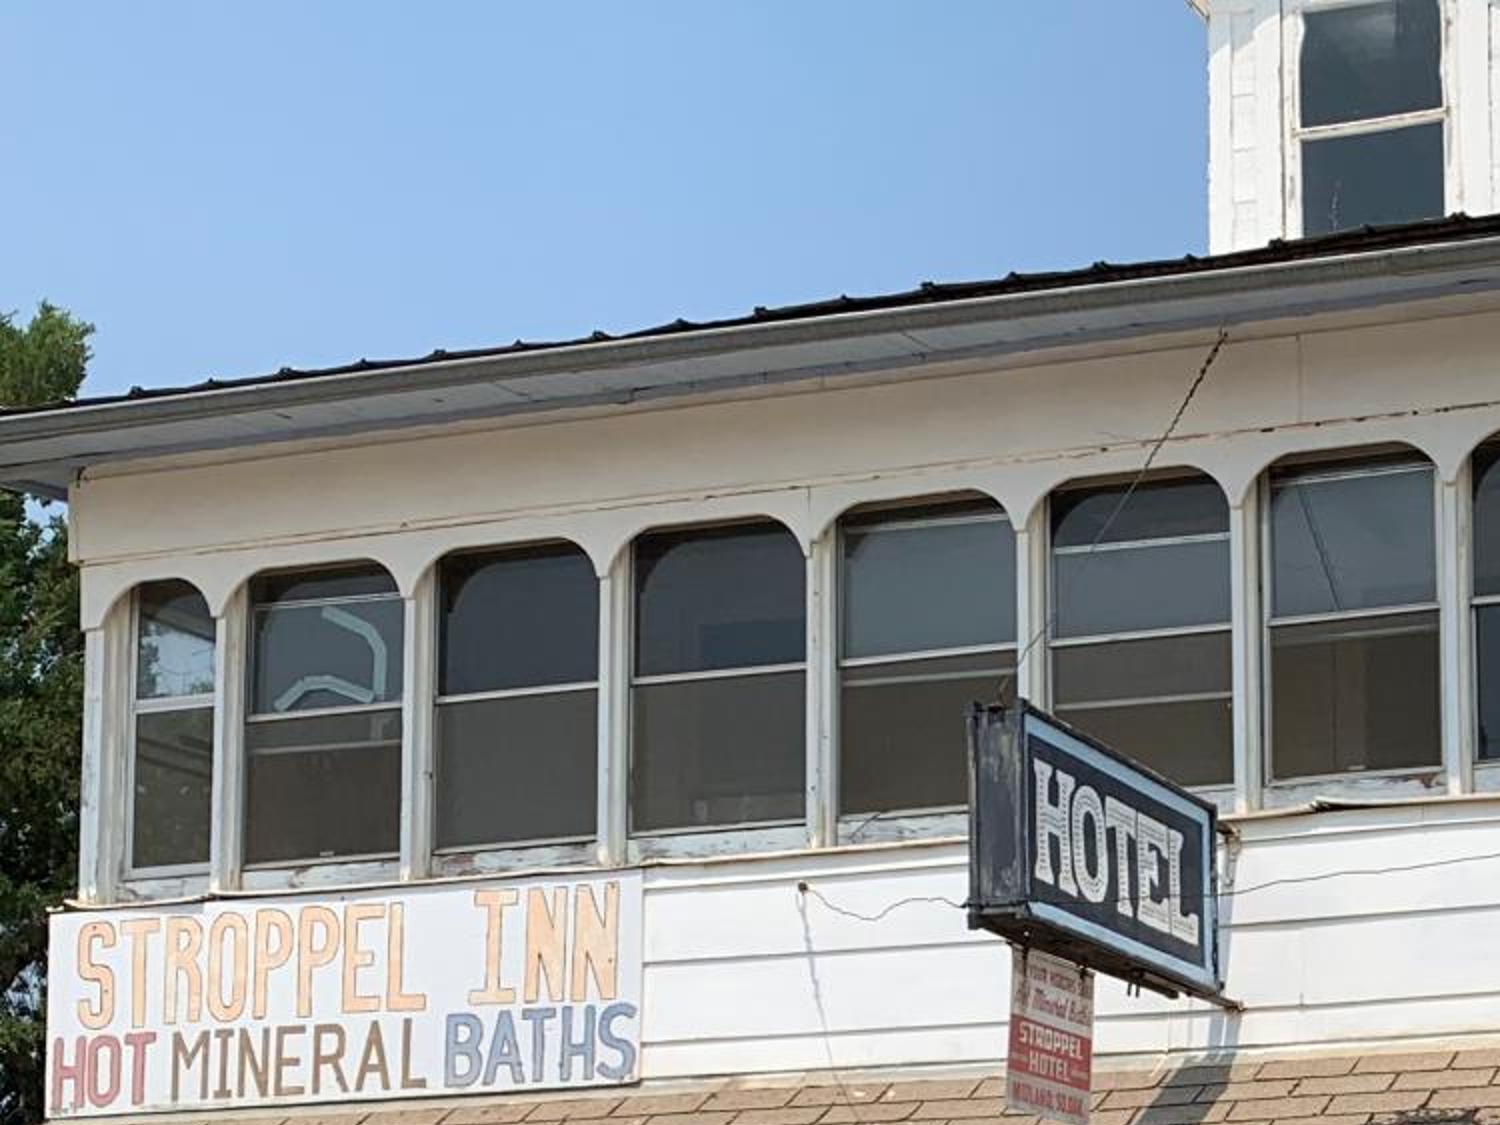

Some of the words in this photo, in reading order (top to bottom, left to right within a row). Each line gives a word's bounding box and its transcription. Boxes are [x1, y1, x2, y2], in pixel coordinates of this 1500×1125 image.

[1033, 757, 1199, 946] HOTEL
[75, 901, 427, 1030] STROPPEL
[468, 881, 620, 1005] INN
[50, 1031, 157, 1111] HOT
[171, 1017, 428, 1102] MINERAL
[443, 1001, 638, 1090] BATHS
[1018, 1021, 1084, 1060] STROPPEL
[1028, 1052, 1073, 1083] HOTEL
